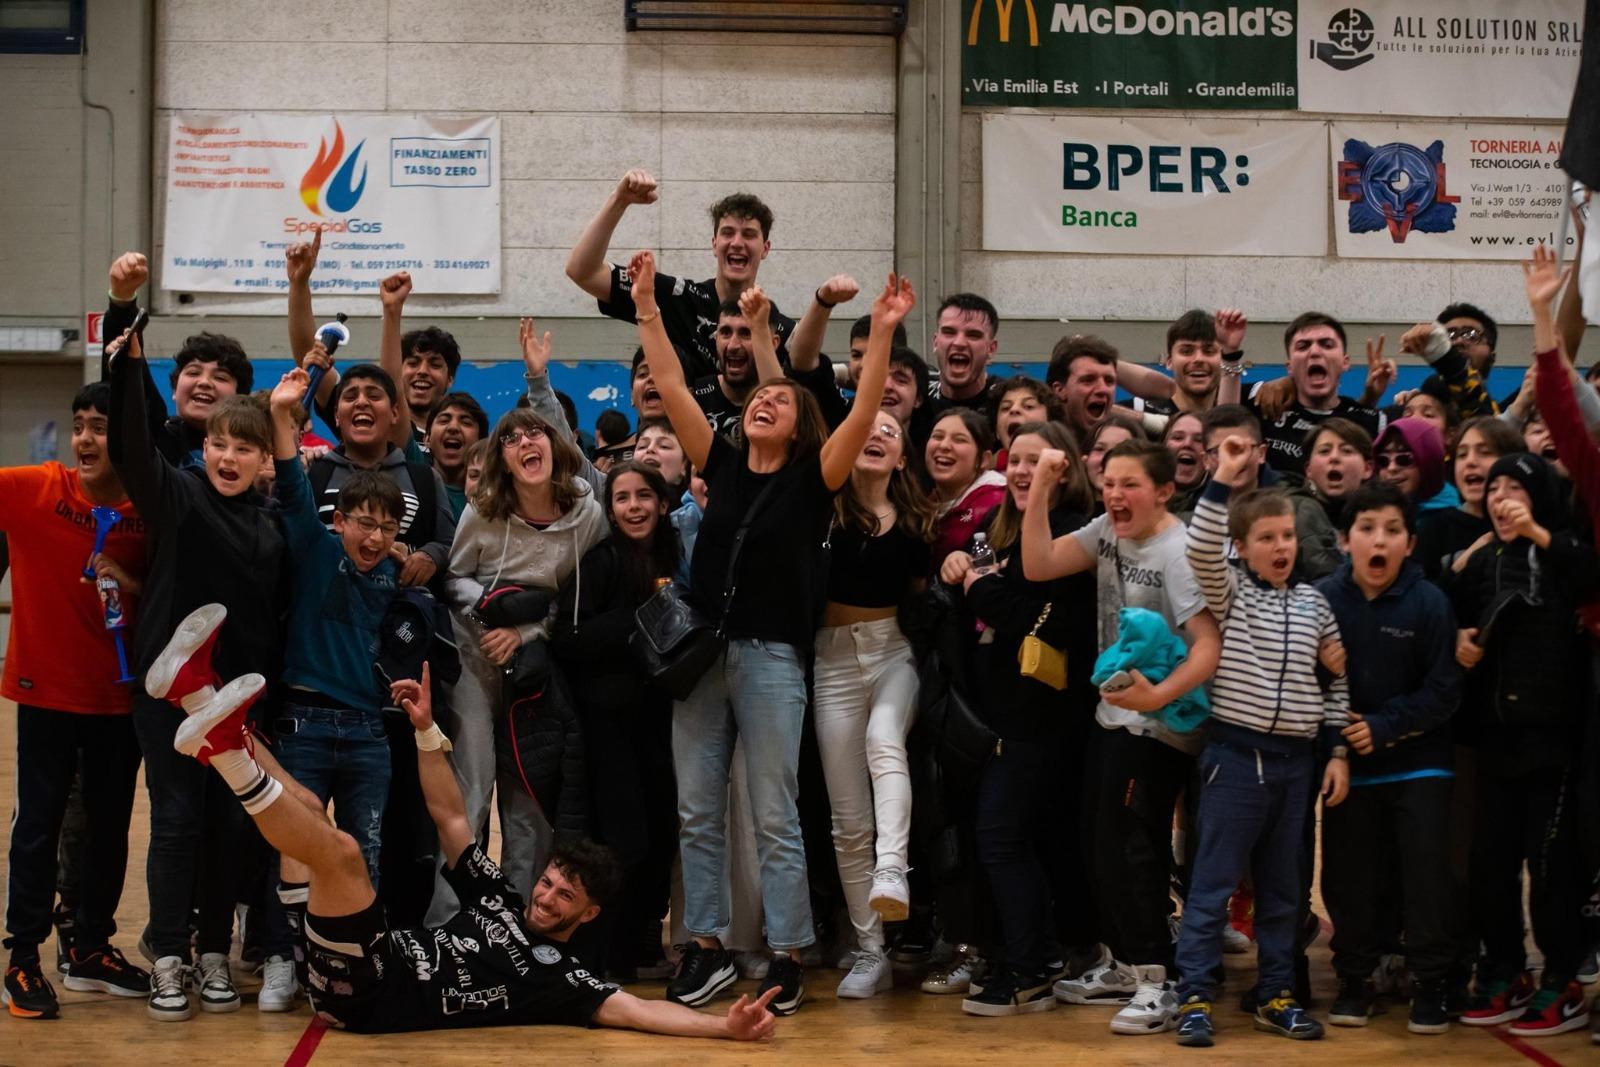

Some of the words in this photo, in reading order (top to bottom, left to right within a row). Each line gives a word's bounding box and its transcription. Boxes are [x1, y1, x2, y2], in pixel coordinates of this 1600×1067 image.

[1050, 2, 1294, 37] McDonald's
[1393, 16, 1427, 38] ALL
[1437, 17, 1537, 41] SOLUTION
[1548, 20, 1582, 43] SRL
[1376, 41, 1407, 53] Tutte
[1412, 42, 1423, 53] le
[1429, 43, 1485, 55] soluzioni
[1491, 45, 1510, 57] per
[1515, 44, 1525, 56] la
[1531, 46, 1549, 57] tua
[972, 79, 998, 93] Via
[1003, 79, 1048, 94] Emilia
[1054, 80, 1079, 95] Est
[1114, 81, 1169, 96] Portali
[1196, 82, 1295, 97] Grandemilia
[1470, 139, 1542, 154] TORNERIA
[394, 149, 487, 160] FINANZIAMENTI
[404, 165, 442, 176] TASSO
[444, 166, 477, 176] ZERO
[1063, 142, 1250, 194] BPER:
[1470, 158, 1541, 170] TECNOLOGIA
[1470, 184, 1486, 193] Via
[1515, 183, 1532, 194] 1/3
[1470, 197, 1482, 207] Tel
[1487, 197, 1504, 207] +39
[1508, 197, 1526, 207] 059
[1530, 197, 1562, 208] 643989
[1062, 204, 1137, 228] Banca
[1470, 210, 1489, 219] mail:
[174, 257, 187, 267] Via
[264, 260, 287, 269] 4101
[367, 260, 383, 270] 059
[234, 277, 272, 287] e-mail:
